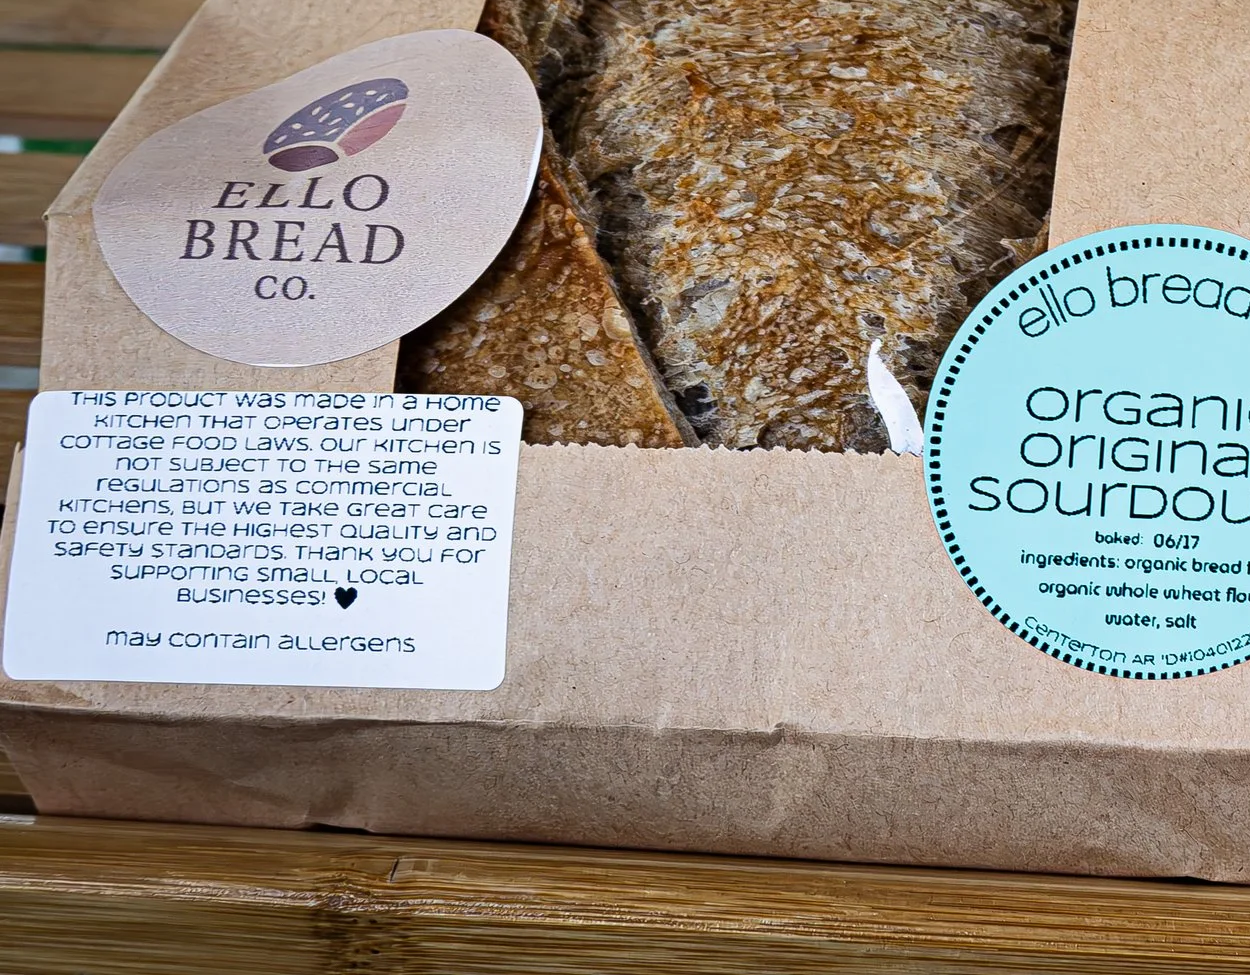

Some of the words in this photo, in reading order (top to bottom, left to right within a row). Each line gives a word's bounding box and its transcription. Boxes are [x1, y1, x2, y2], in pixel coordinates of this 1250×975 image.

[211, 174, 390, 211] ELLO
[179, 219, 405, 264] BREAD
[254, 275, 316, 301] CO.
[1017, 283, 1096, 338] ello
[70, 391, 118, 408] THIS
[171, 435, 238, 451] FOOD
[482, 440, 502, 455] IS
[276, 458, 307, 473] TO
[47, 519, 77, 535] TO
[1094, 530, 1144, 546] baked:
[1153, 533, 1200, 550] 06/17
[1020, 549, 1120, 569] ingredients:
[1123, 556, 1188, 574] organic
[1191, 557, 1243, 575] bread
[1038, 580, 1102, 599] organic
[1105, 581, 1159, 600] whole
[1162, 584, 1222, 603] wheat
[1104, 612, 1161, 630] water,
[1164, 613, 1198, 630] salt
[1132, 654, 1155, 665] AR
